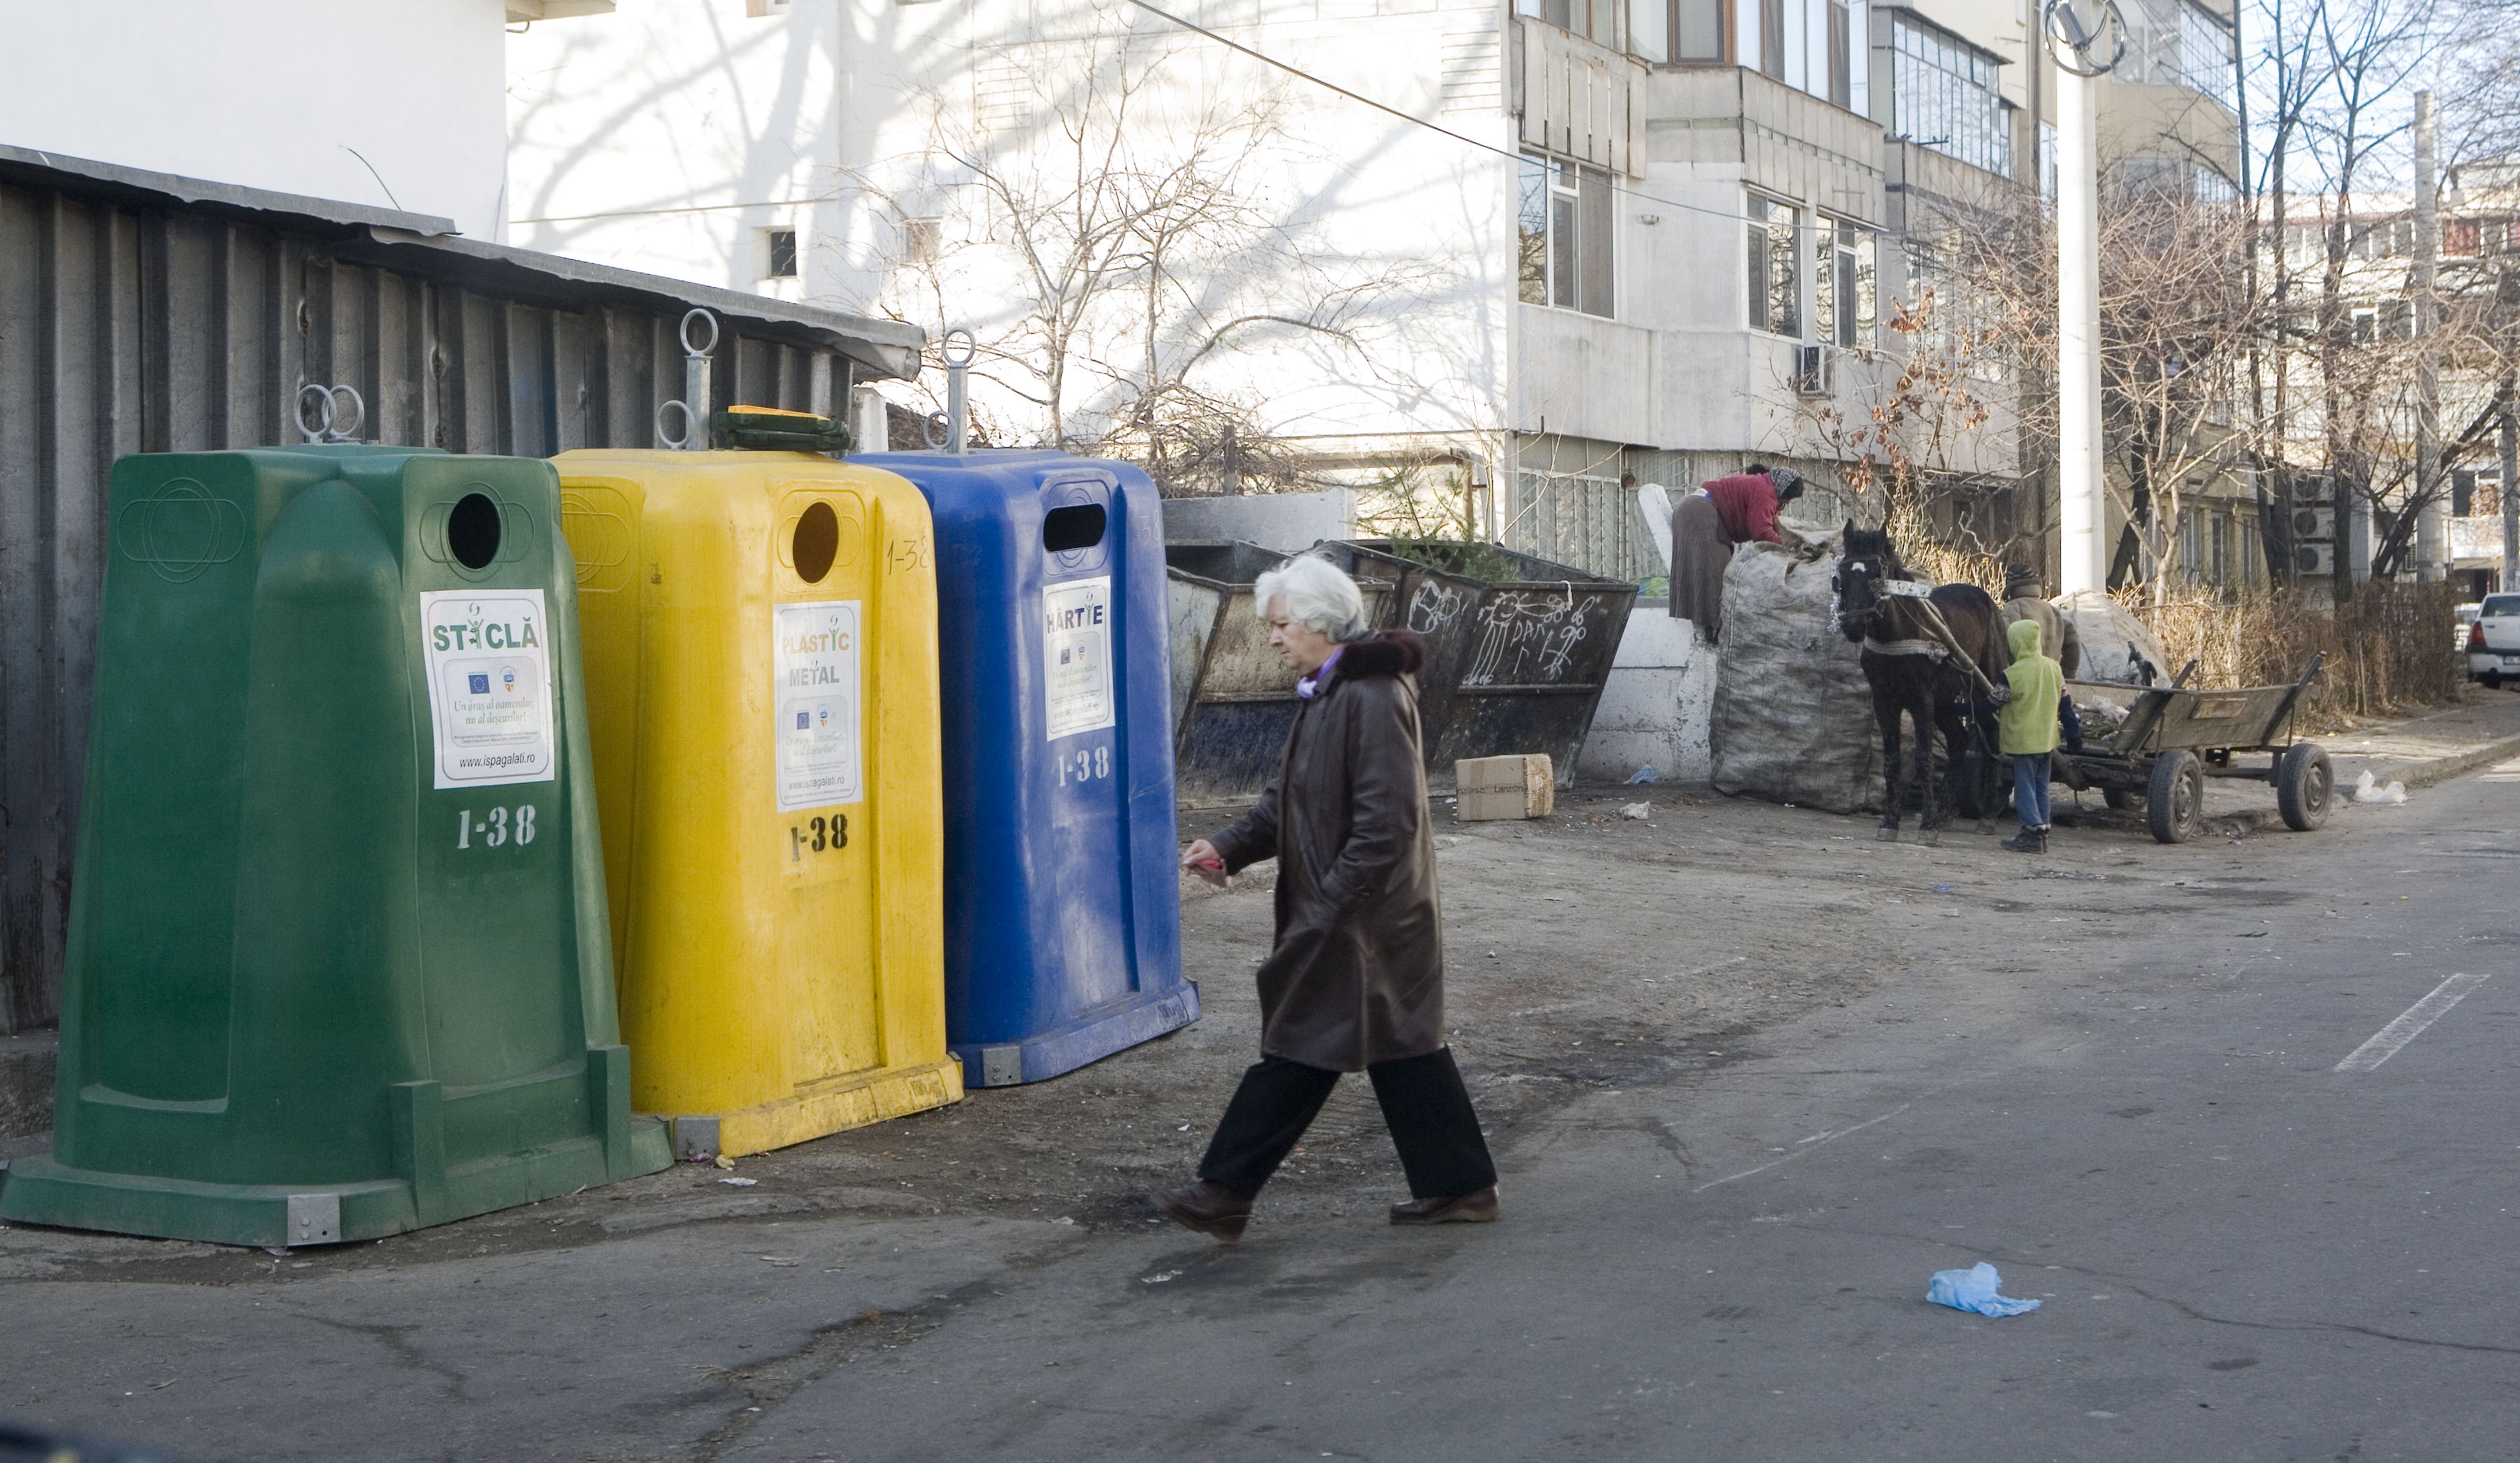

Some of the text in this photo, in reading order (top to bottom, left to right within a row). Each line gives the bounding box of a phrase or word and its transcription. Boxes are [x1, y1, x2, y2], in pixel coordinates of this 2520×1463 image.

[887, 535, 930, 575] 1-38
[433, 616, 539, 651] STICLĂ
[782, 628, 850, 655] PLASTIC
[789, 665, 840, 687] METAL
[454, 701, 467, 712] Un
[486, 698, 494, 710] al
[478, 712, 485, 724] al
[460, 752, 536, 768] www.ispagalati.ro
[1058, 746, 1109, 788] 1-38
[789, 774, 844, 790] www.ispagalati.ro
[456, 804, 536, 849] 1-38
[791, 814, 848, 862] 1-38
